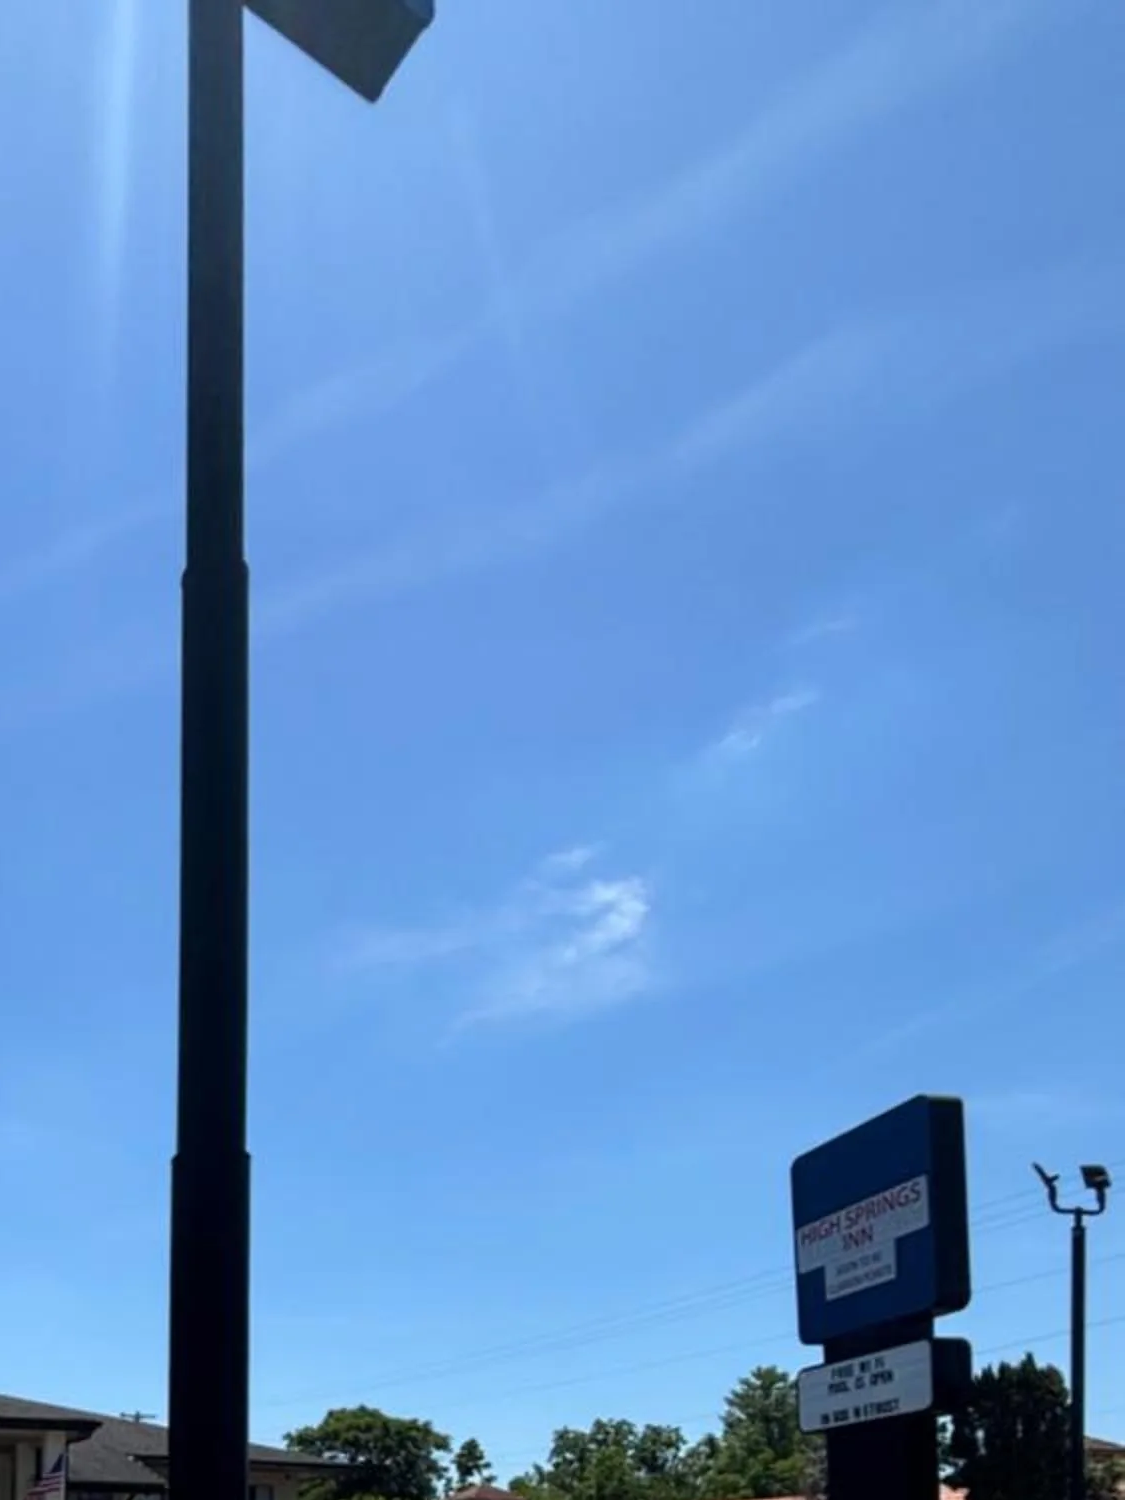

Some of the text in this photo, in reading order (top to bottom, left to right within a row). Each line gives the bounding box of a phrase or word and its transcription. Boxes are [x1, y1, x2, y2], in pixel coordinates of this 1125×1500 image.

[801, 1182, 921, 1246] HIGH SPRINGS
[842, 1225, 874, 1250] INN
[869, 1370, 894, 1386] OPEN
